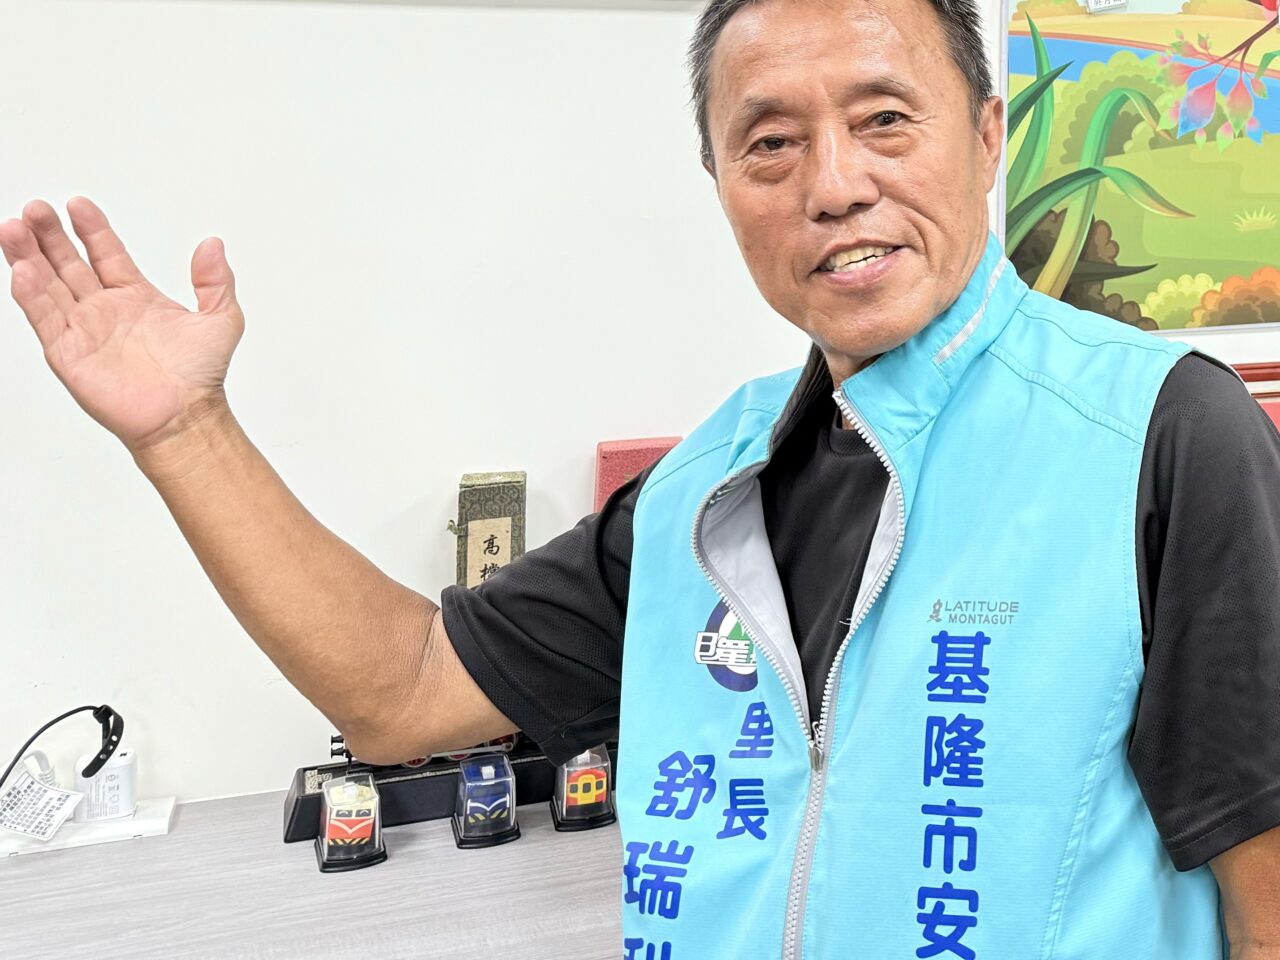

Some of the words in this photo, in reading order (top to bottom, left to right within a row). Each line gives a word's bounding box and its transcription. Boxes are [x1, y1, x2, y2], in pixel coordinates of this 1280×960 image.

[944, 600, 1020, 613] LATITUDE
[948, 613, 1016, 625] MONTAGUT
[716, 701, 775, 841] 里長
[915, 630, 992, 960] 基隆市安
